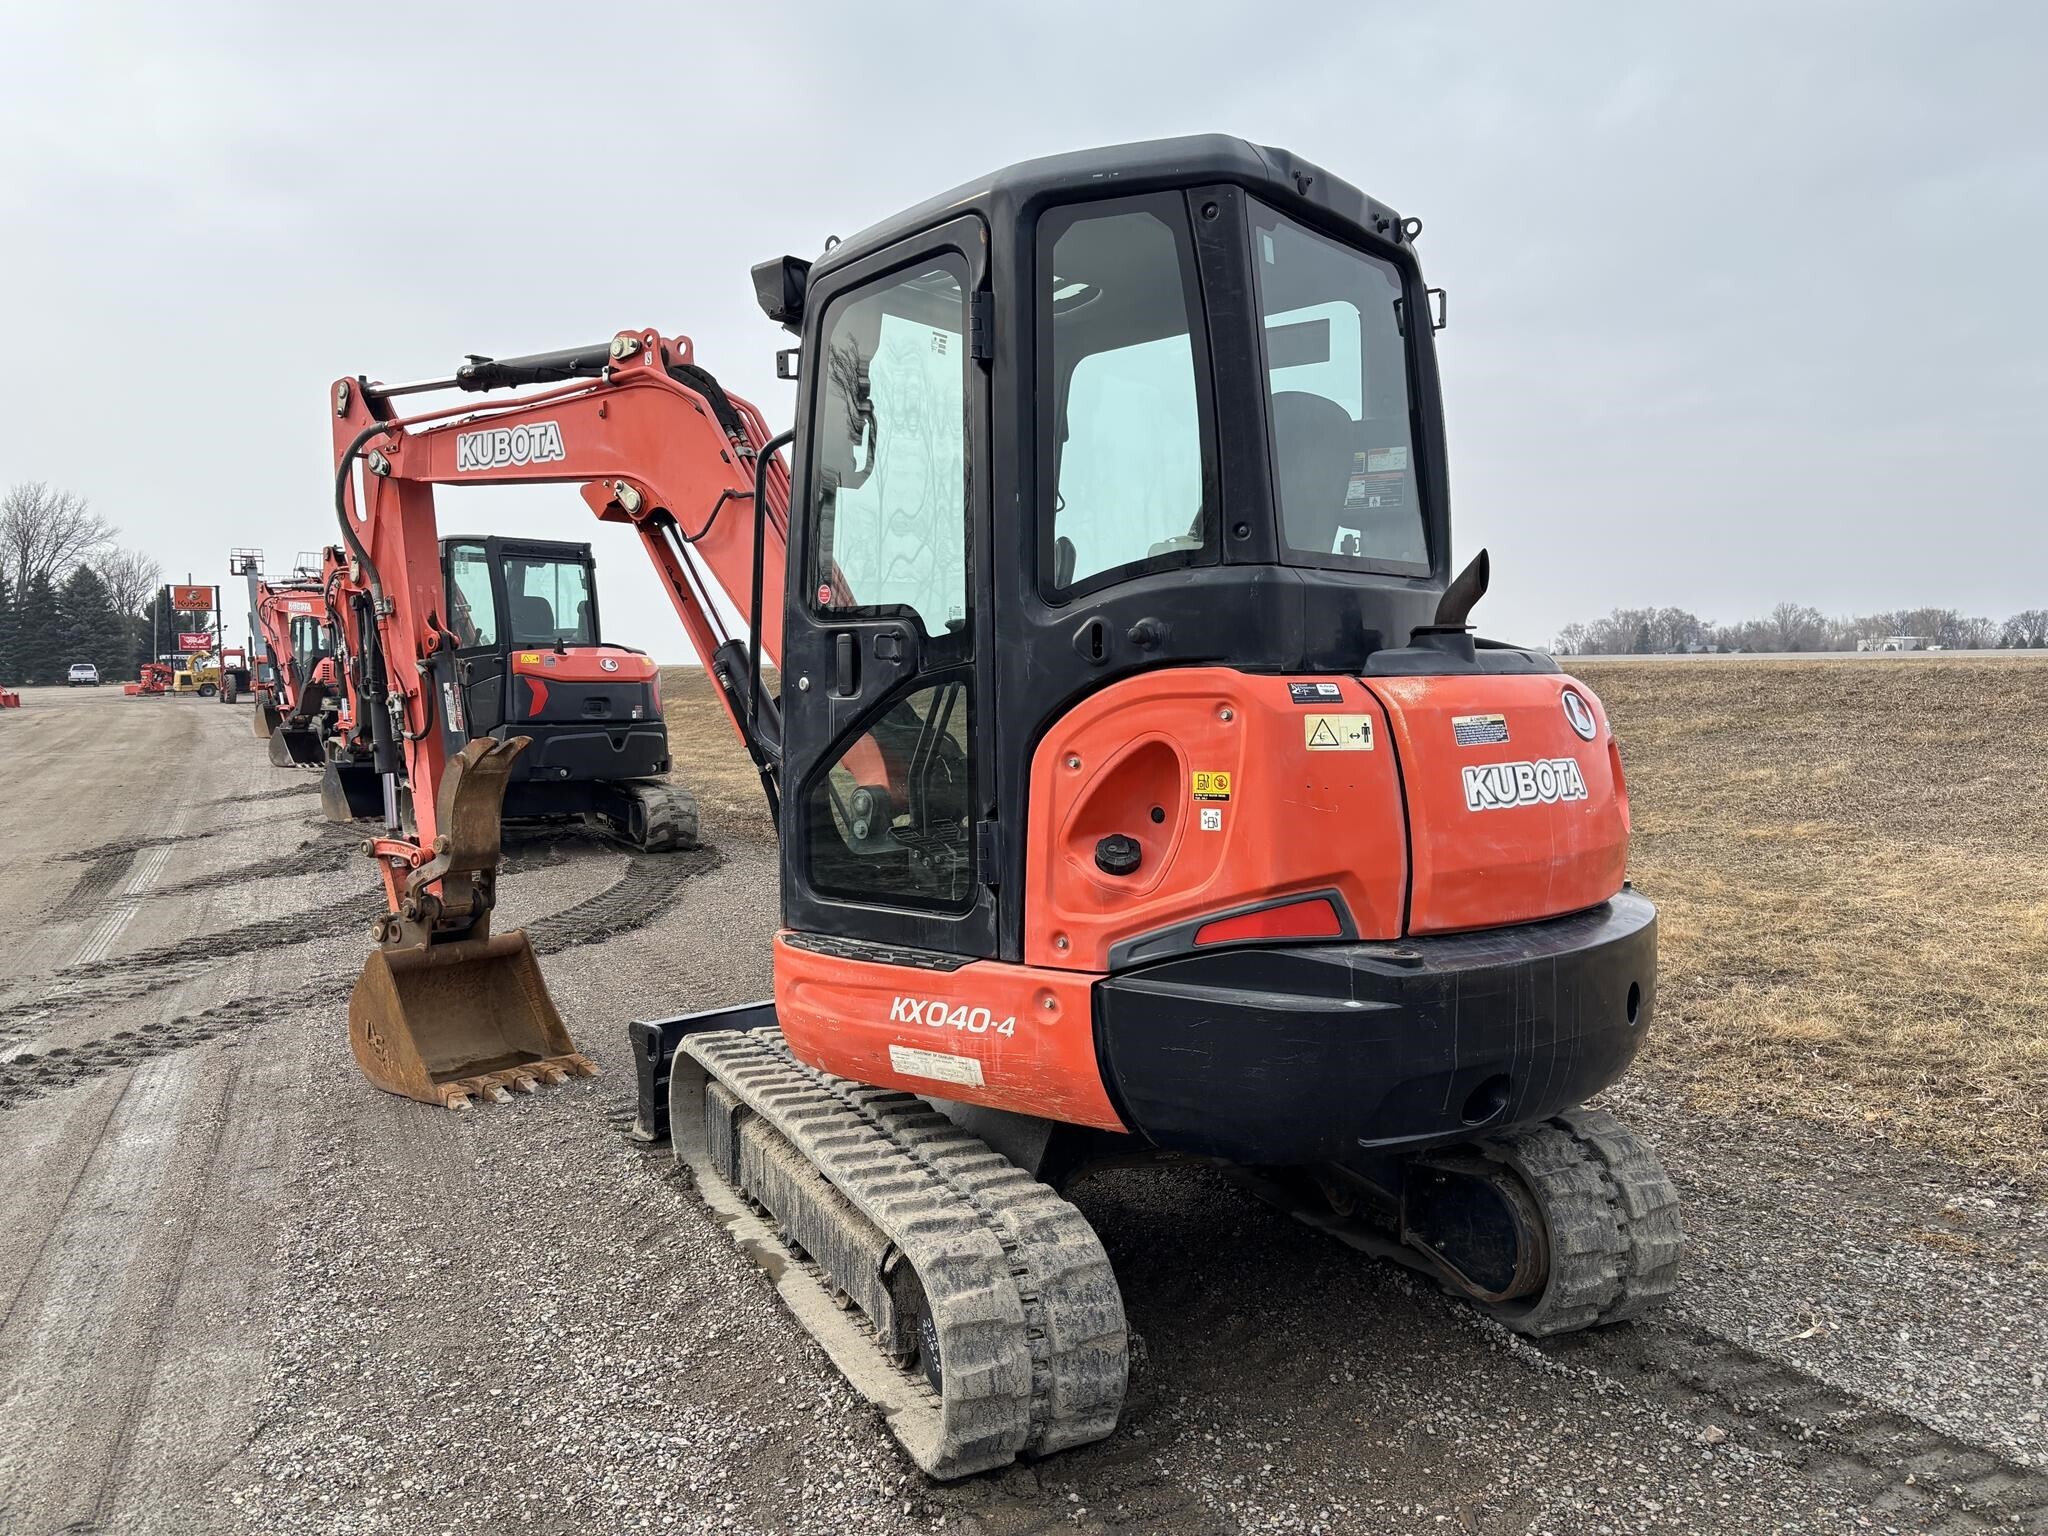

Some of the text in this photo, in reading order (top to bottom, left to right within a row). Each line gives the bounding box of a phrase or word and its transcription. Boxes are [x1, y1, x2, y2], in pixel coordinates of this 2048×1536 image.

[457, 421, 565, 471] KUBOTA
[177, 600, 210, 608] Kubota
[1462, 759, 1588, 811] KUBOTA
[890, 996, 1016, 1037] KX040-4
